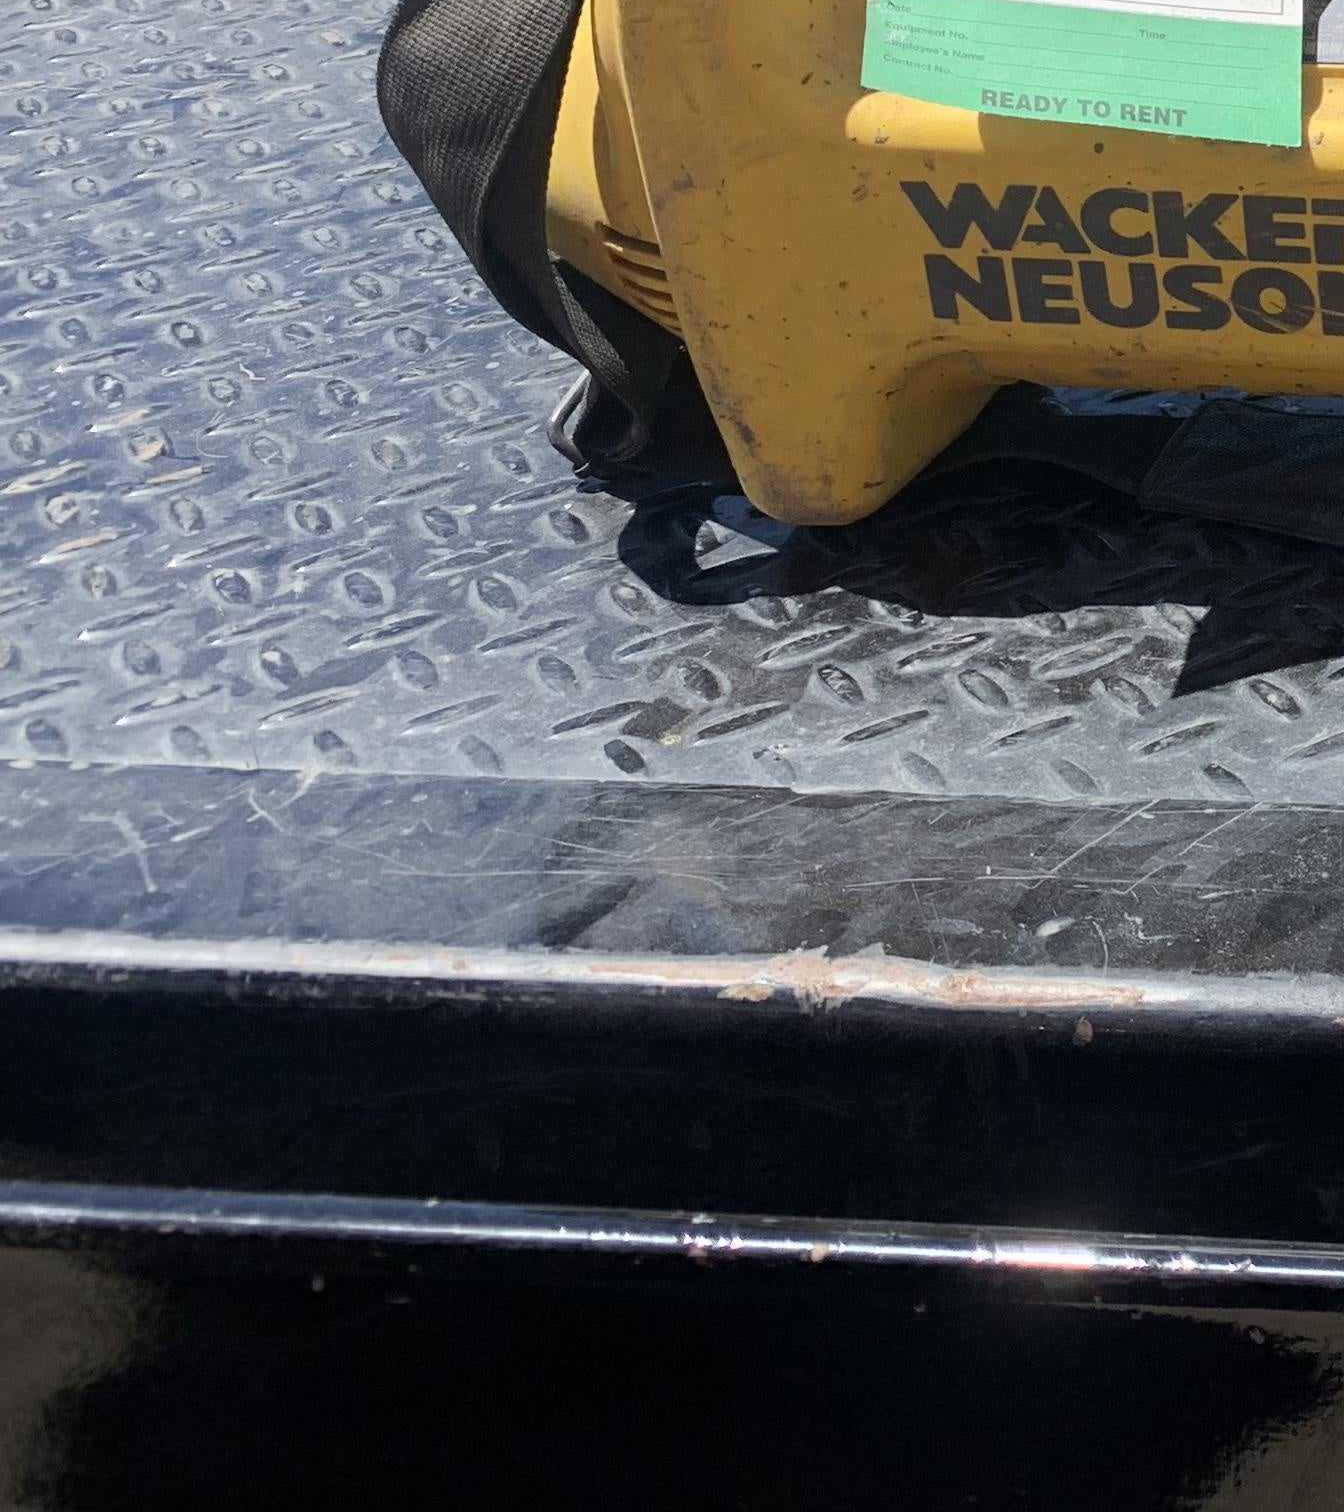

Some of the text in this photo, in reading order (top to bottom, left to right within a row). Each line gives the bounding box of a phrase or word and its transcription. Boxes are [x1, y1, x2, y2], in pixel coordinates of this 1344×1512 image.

[886, 1, 911, 13] Date
[885, 21, 969, 40] Equipment No.
[1139, 29, 1166, 40] Time
[883, 54, 931, 72] Contract
[953, 50, 985, 62] Name
[981, 89, 1187, 127] READY TO RENT
